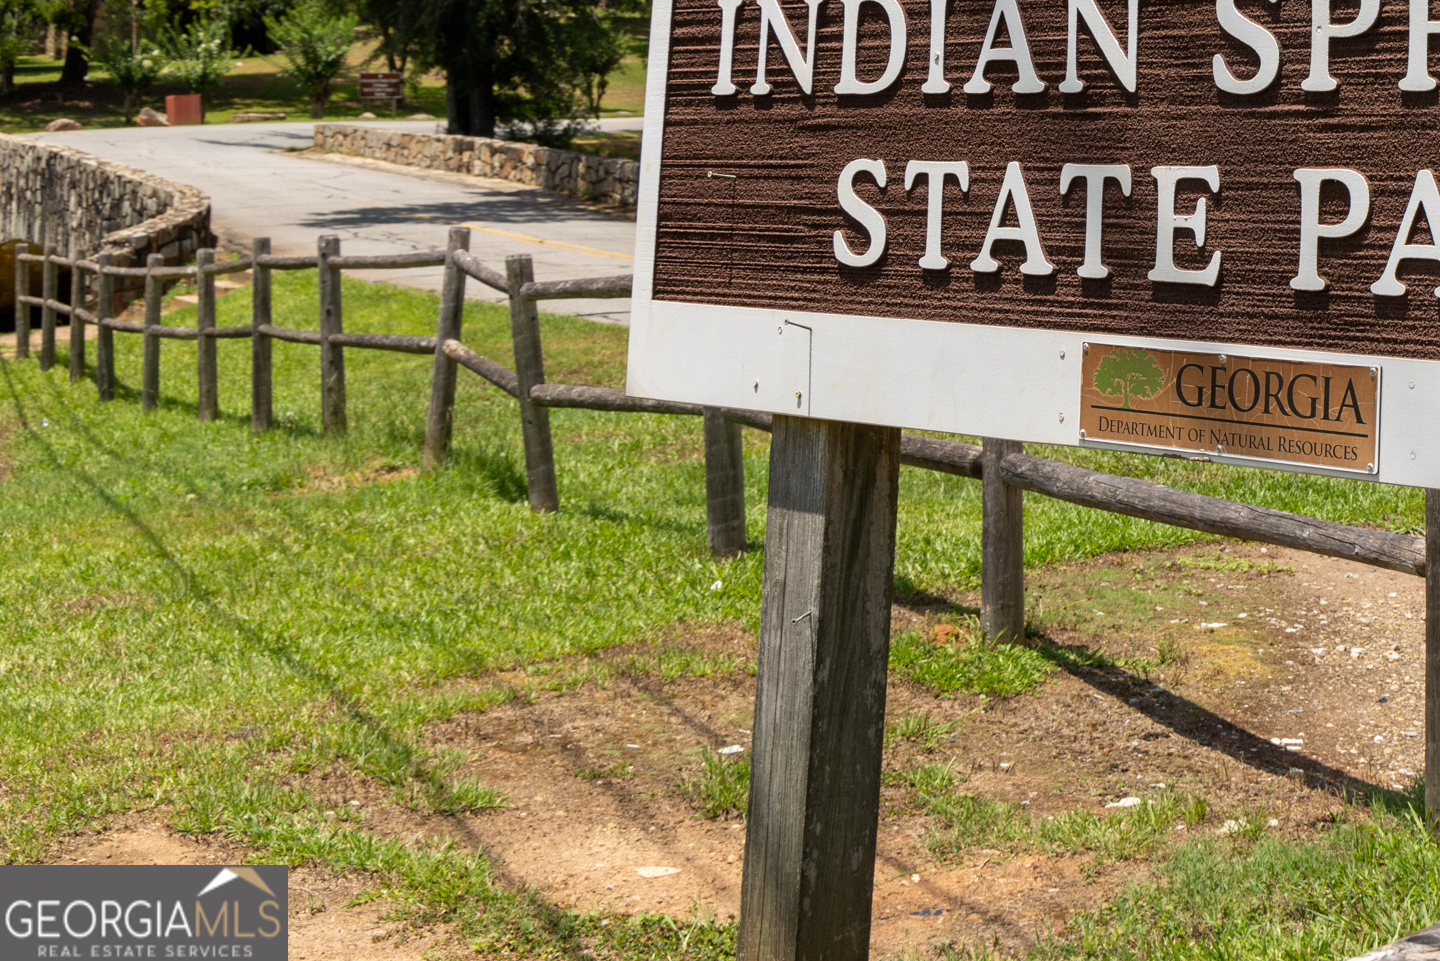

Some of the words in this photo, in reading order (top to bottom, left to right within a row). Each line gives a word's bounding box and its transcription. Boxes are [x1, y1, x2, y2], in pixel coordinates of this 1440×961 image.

[832, 157, 1222, 287] STATE
[1175, 363, 1367, 425] GEORGIA
[1098, 415, 1185, 442] DEPARTMENT
[1209, 428, 1274, 452] NATURAL
[1277, 435, 1358, 461] RESOURCES
